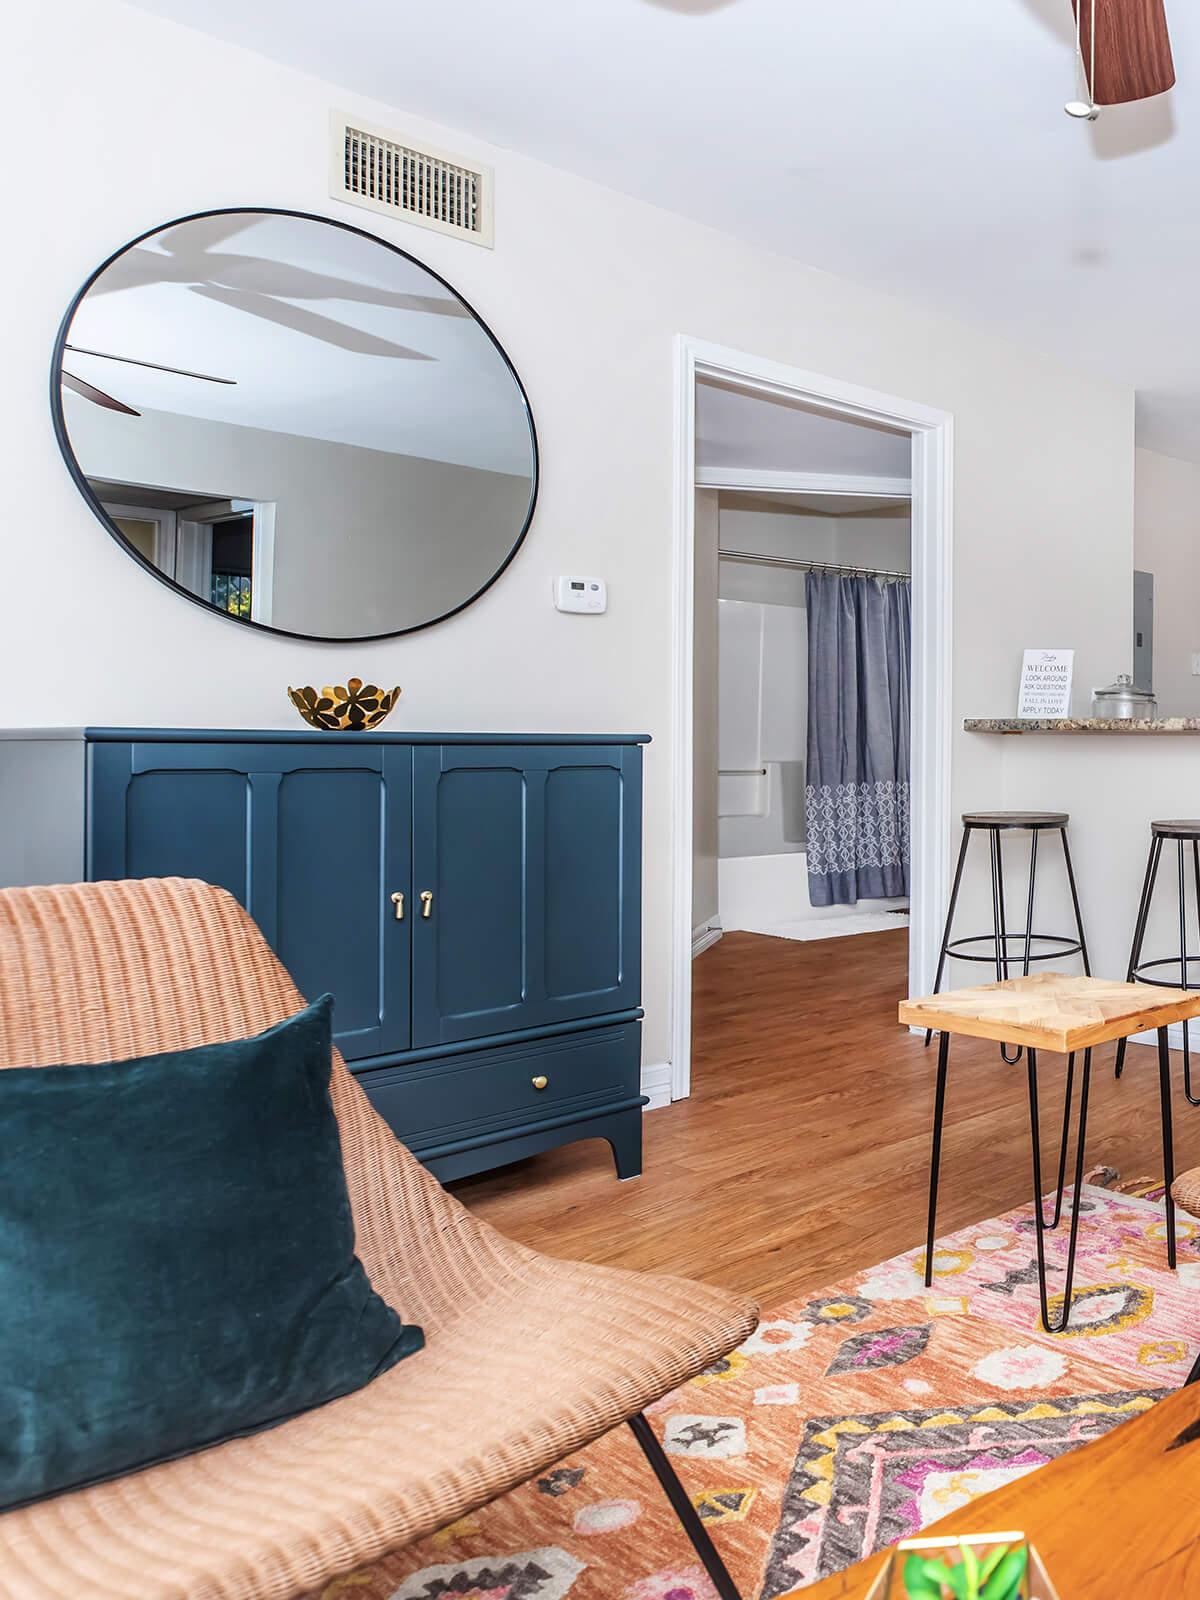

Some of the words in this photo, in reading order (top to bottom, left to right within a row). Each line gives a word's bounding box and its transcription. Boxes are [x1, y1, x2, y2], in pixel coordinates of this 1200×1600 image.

[1027, 664, 1068, 672] WELCOME
[1025, 674, 1042, 682] LOOK
[1043, 674, 1068, 682] AROUND
